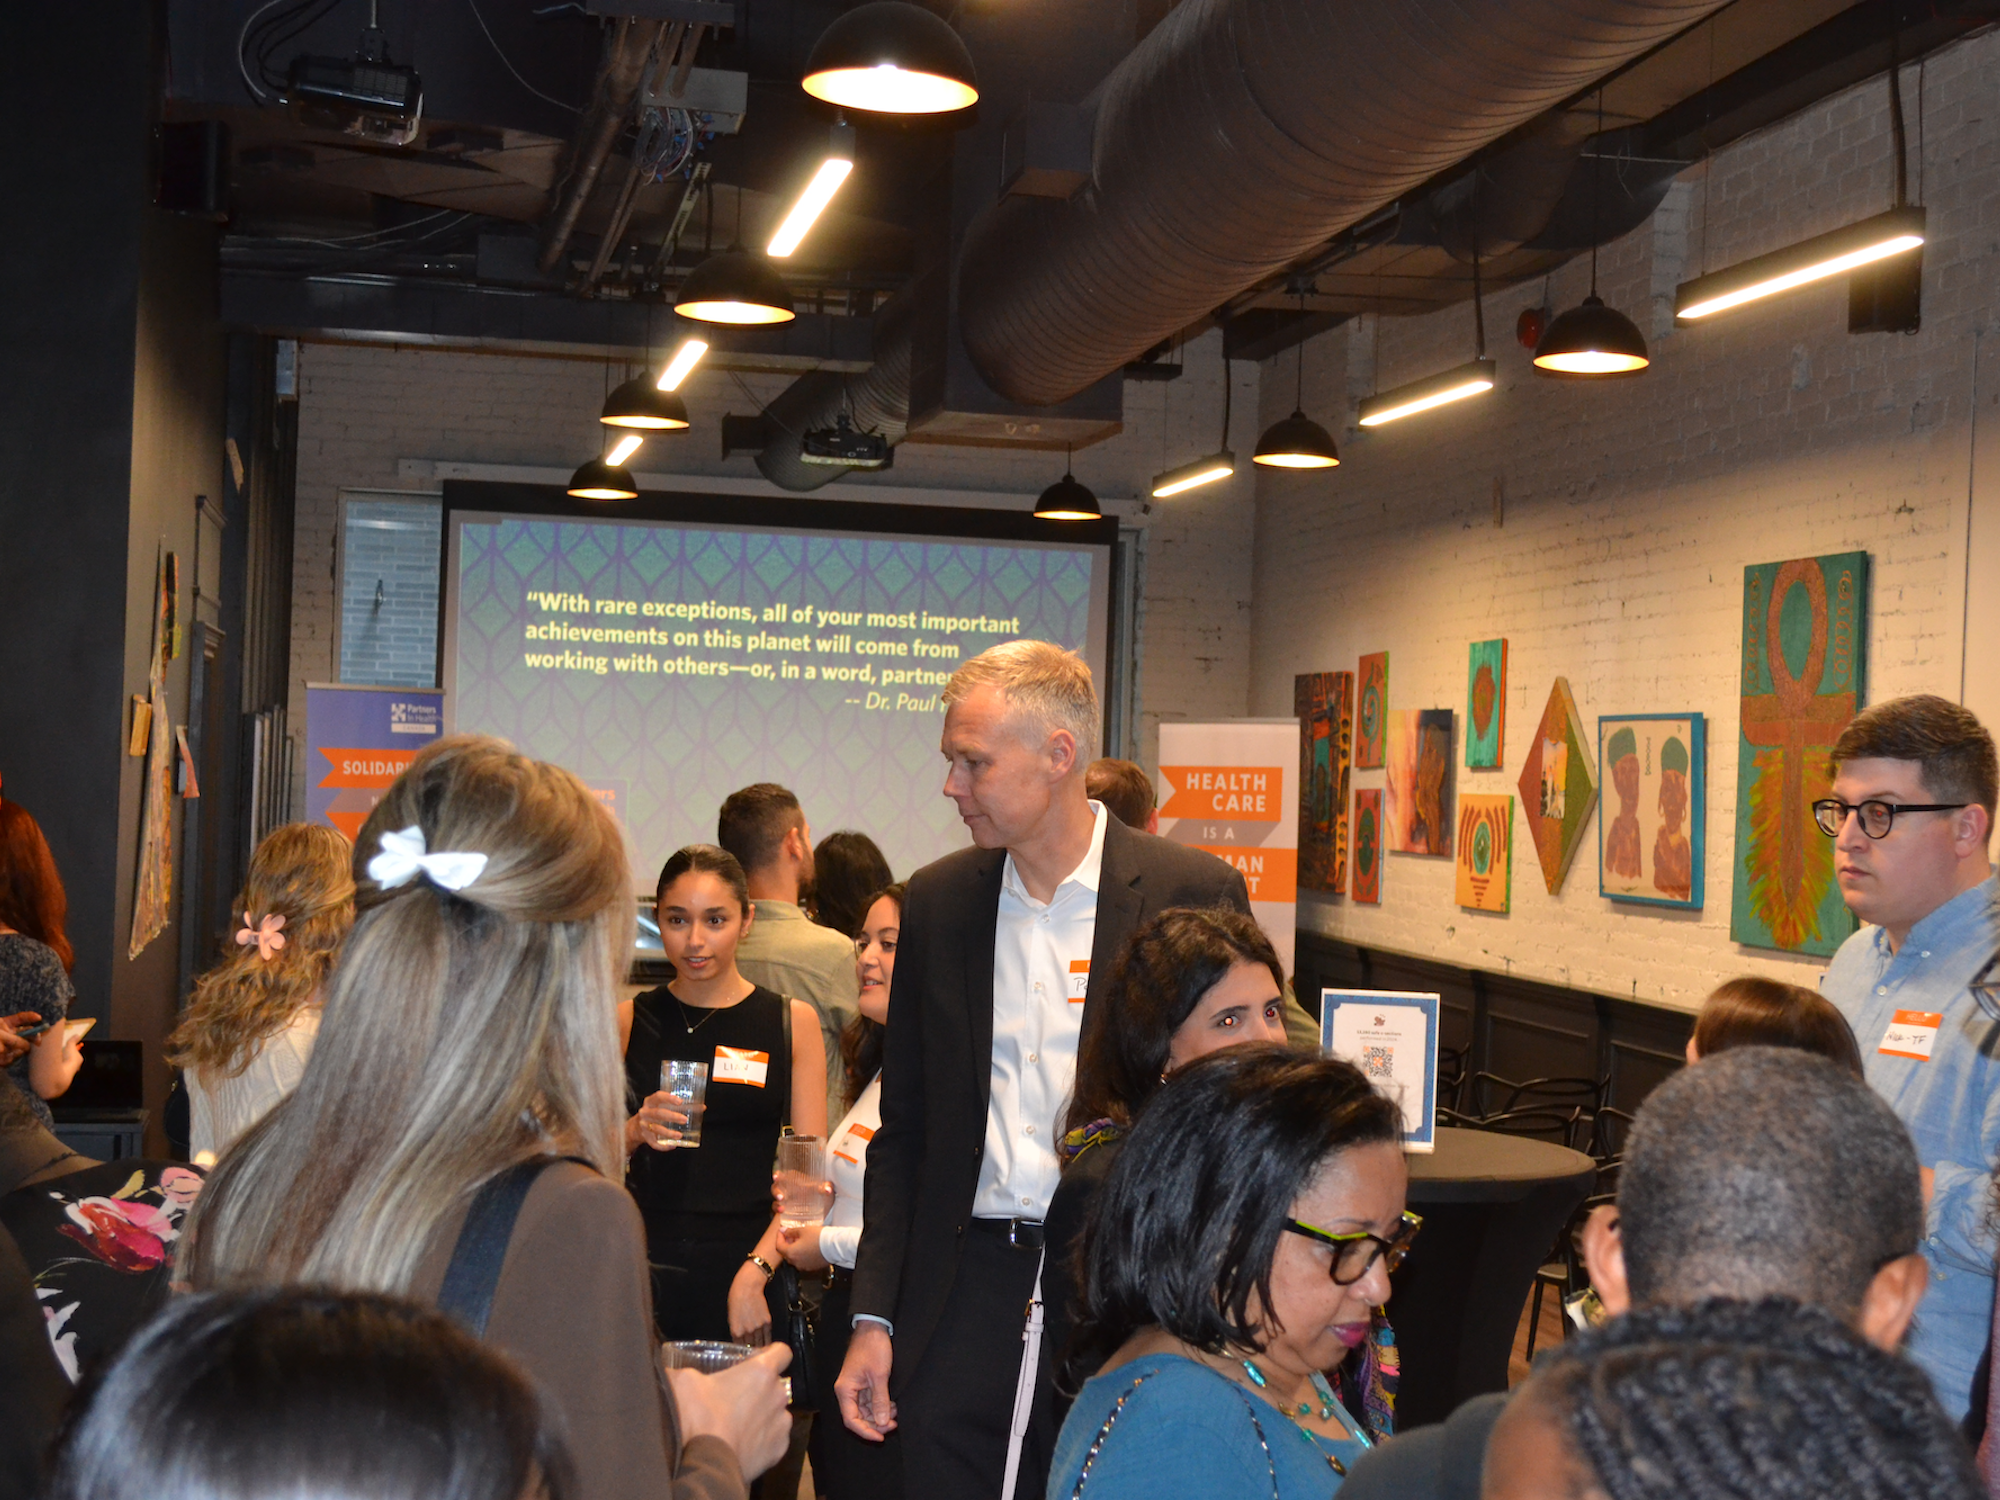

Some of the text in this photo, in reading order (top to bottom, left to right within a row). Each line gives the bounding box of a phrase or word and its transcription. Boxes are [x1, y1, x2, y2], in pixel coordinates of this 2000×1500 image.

[595, 600, 637, 615] rare
[642, 600, 758, 624] exceptions,
[763, 603, 788, 623] all
[792, 604, 813, 624] of
[816, 610, 862, 628] your
[867, 611, 917, 629] most
[921, 611, 1020, 634] important
[525, 620, 960, 658] achievements on this planet will come from
[524, 649, 609, 675] working
[613, 653, 659, 672] with
[781, 659, 800, 679] in
[804, 665, 817, 680] a
[822, 663, 876, 685] word,
[881, 667, 953, 686] partner
[865, 691, 891, 710] Dr.
[896, 693, 937, 712] Paul
[342, 760, 409, 776] SOLIDARI
[1186, 773, 1267, 792] HEALTH
[1212, 793, 1266, 812] CARE
[1203, 826, 1235, 840] IS A
